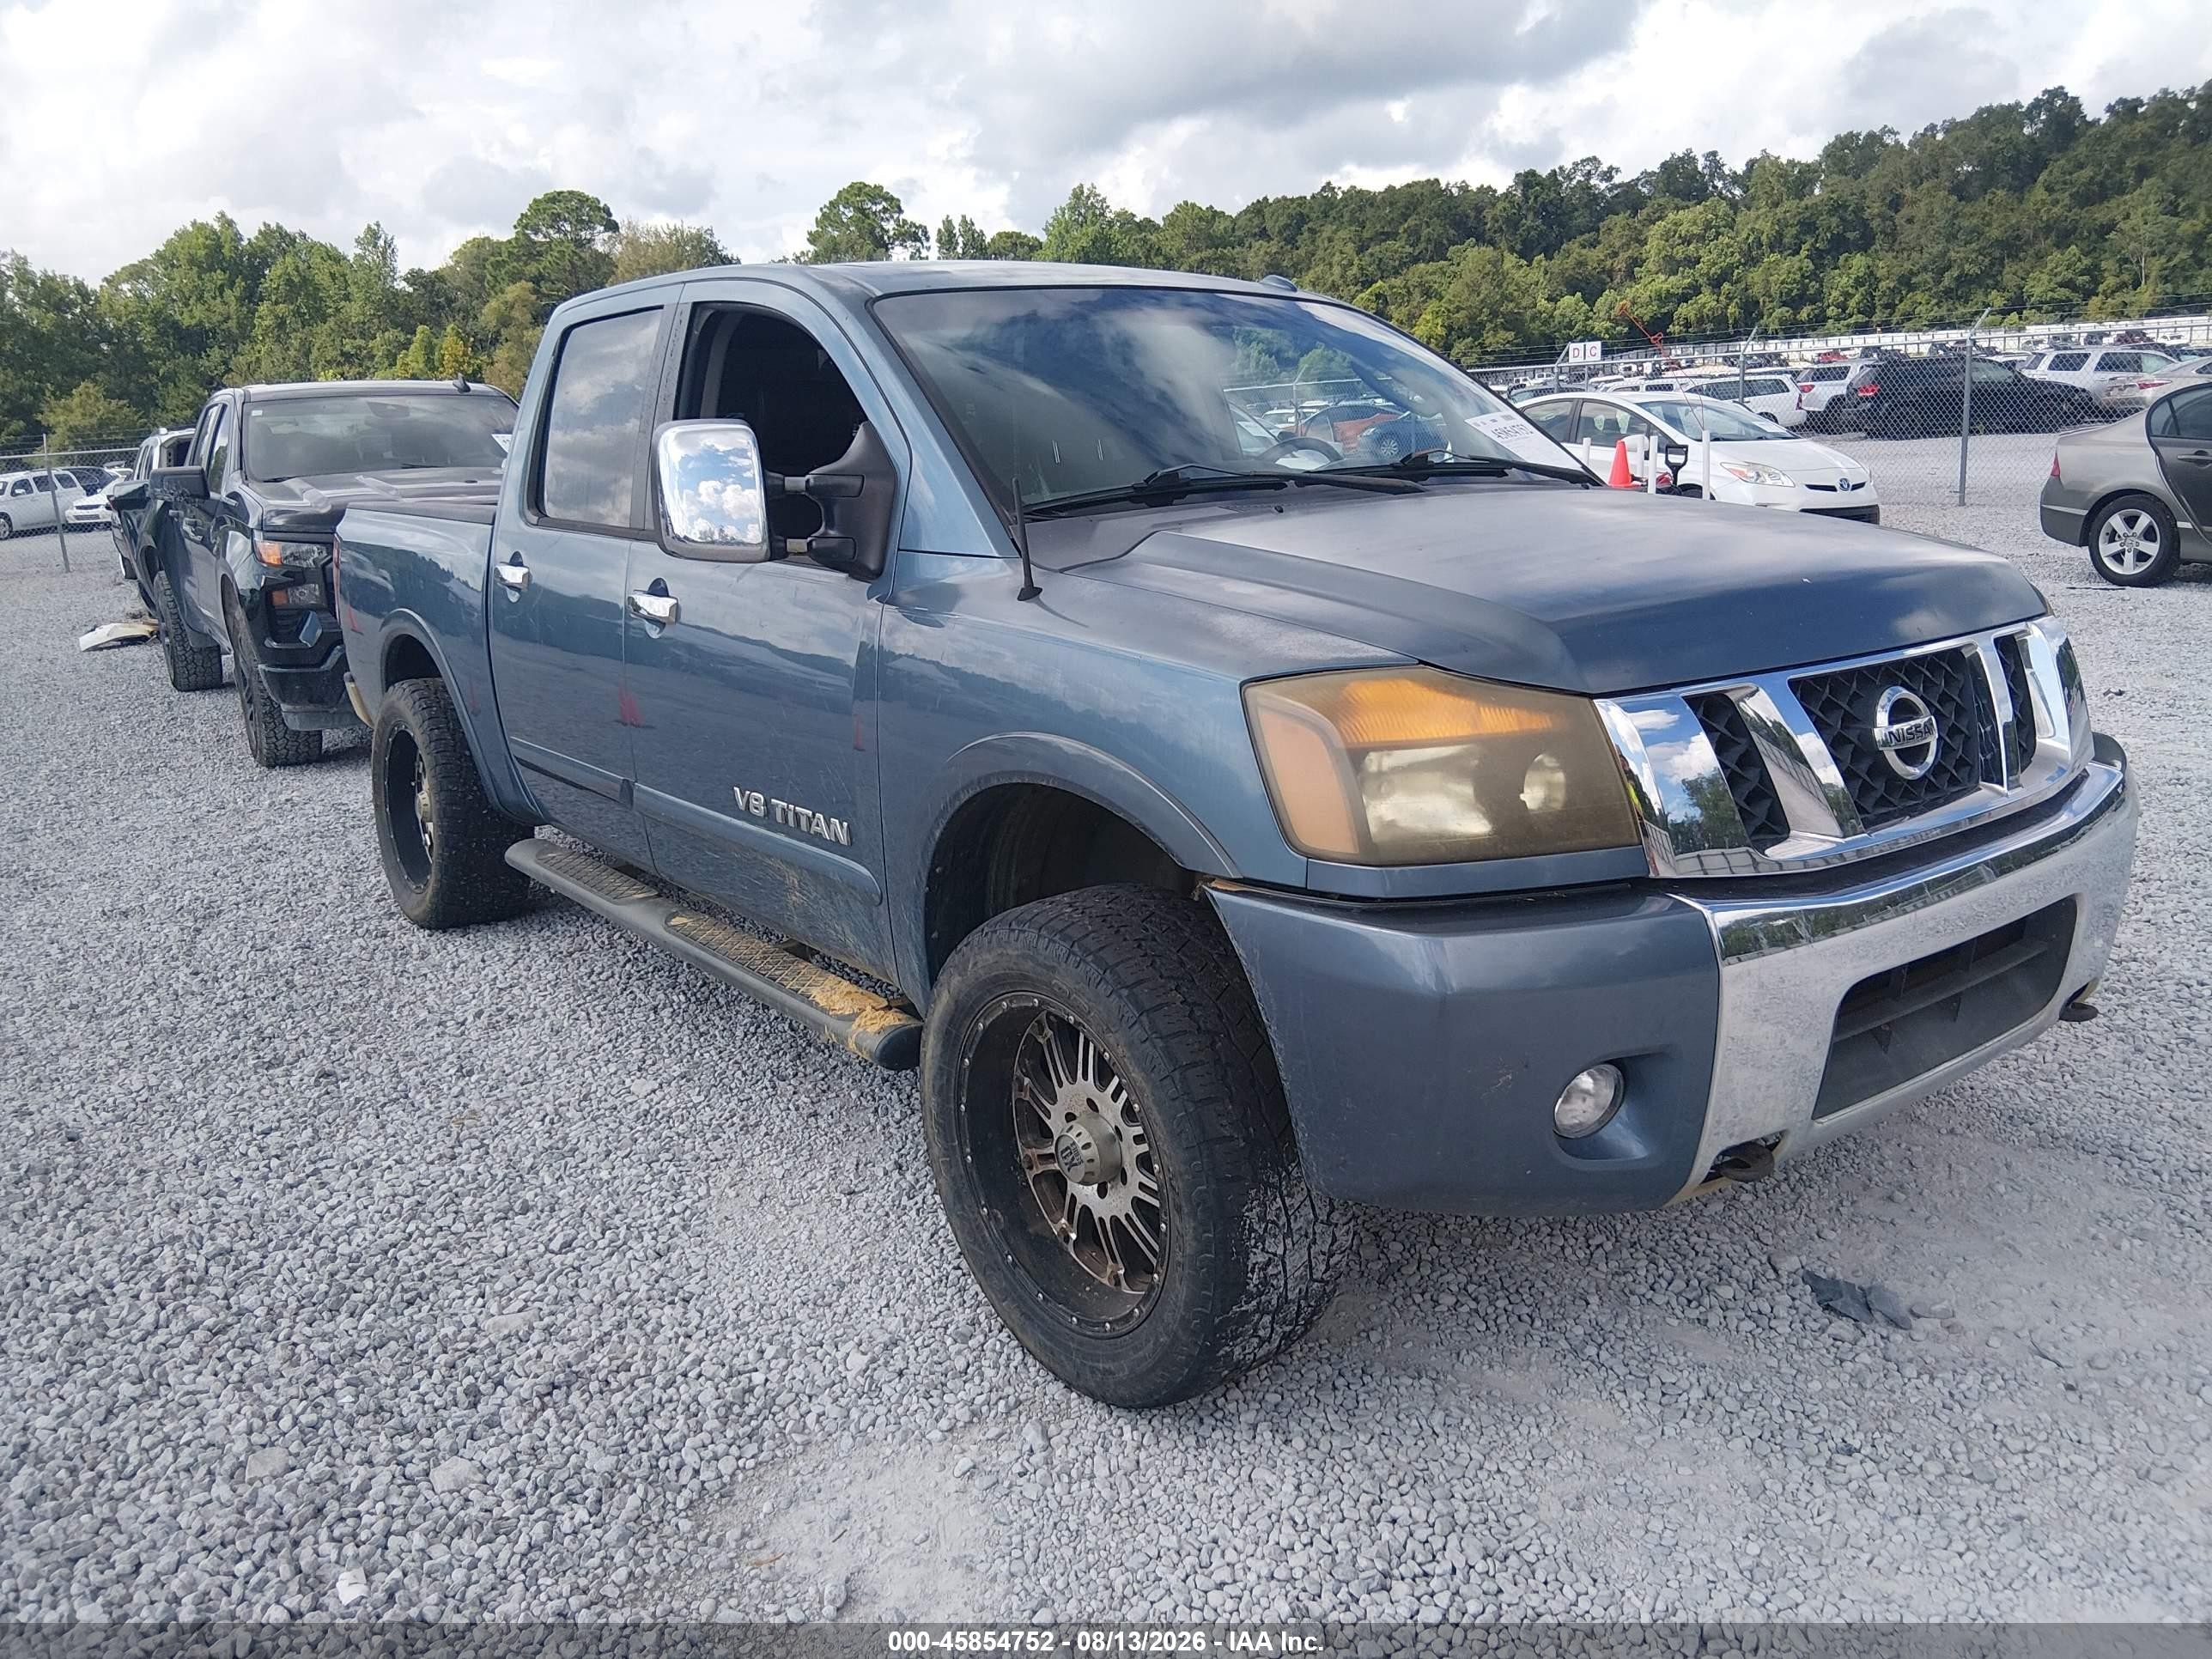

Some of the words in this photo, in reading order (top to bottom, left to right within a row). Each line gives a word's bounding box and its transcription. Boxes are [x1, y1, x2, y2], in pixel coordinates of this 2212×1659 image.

[1573, 348, 1580, 358] D
[1589, 346, 1597, 357] C
[733, 787, 767, 817] V8
[771, 799, 852, 846] TITAN
